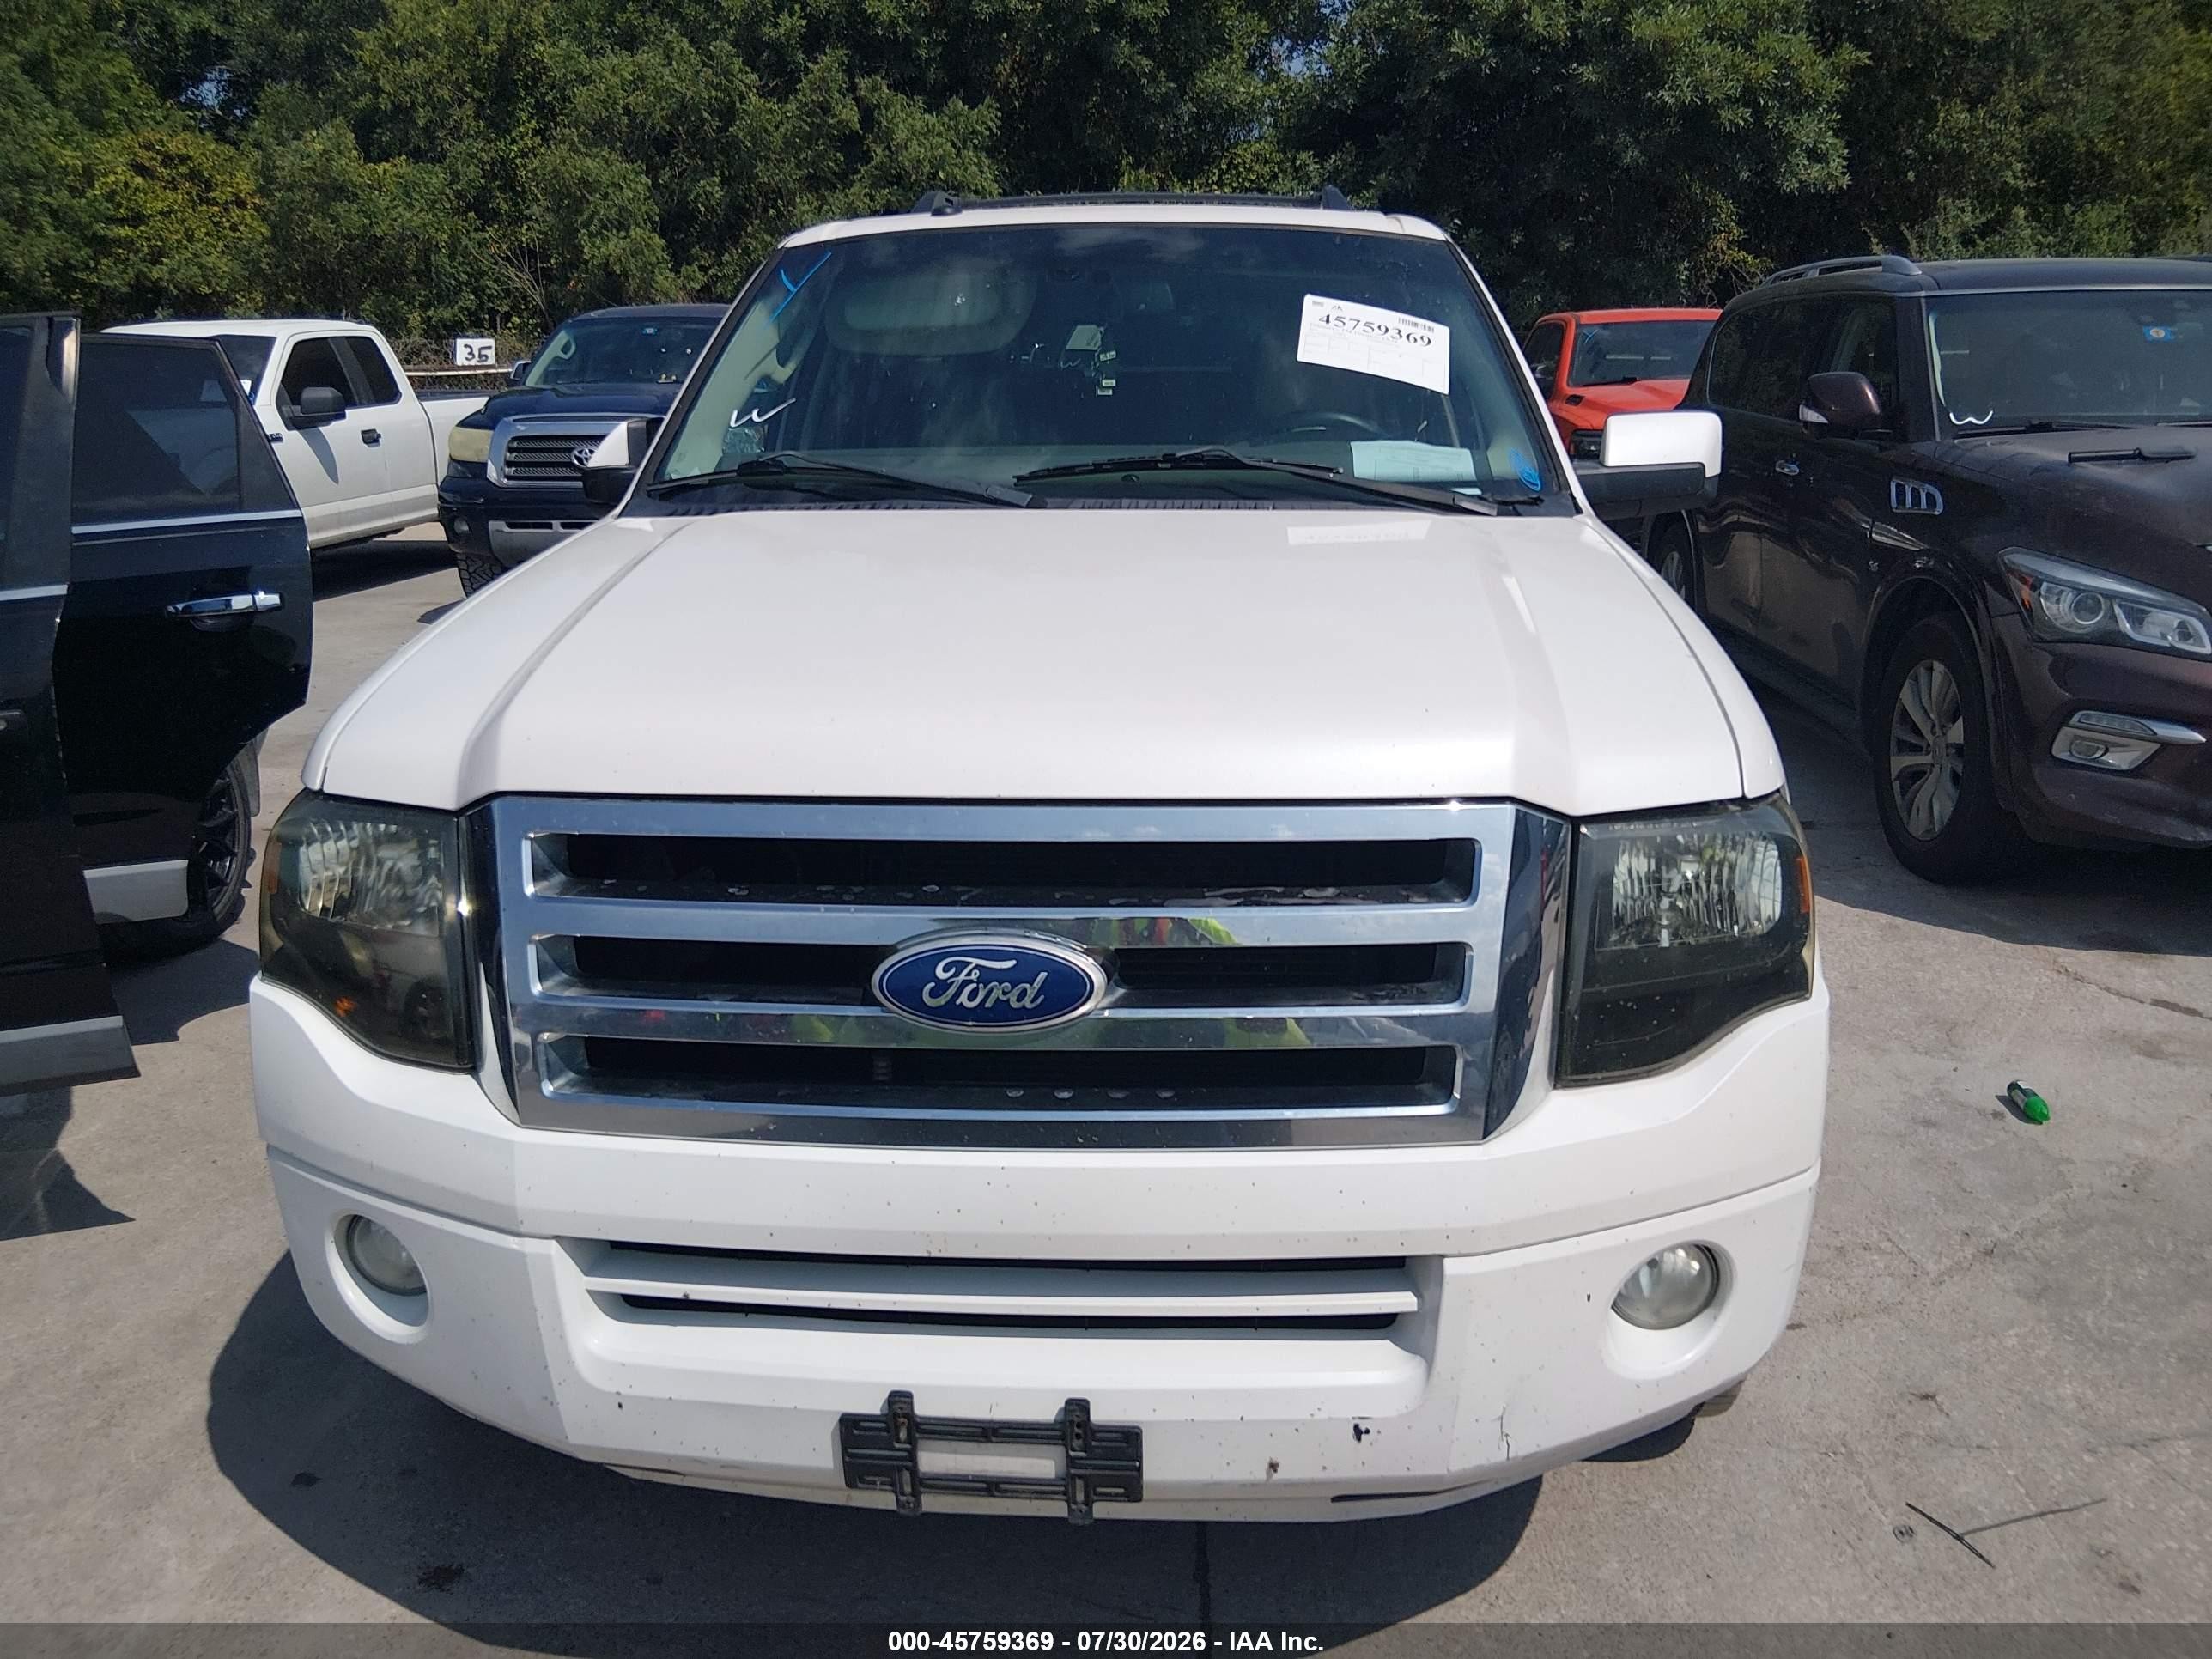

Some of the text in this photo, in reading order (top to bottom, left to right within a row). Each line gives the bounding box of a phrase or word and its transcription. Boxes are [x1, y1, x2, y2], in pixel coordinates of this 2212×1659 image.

[1318, 313, 1432, 348] 45759369
[464, 343, 493, 363] 35
[921, 956, 1048, 1009] Ford
